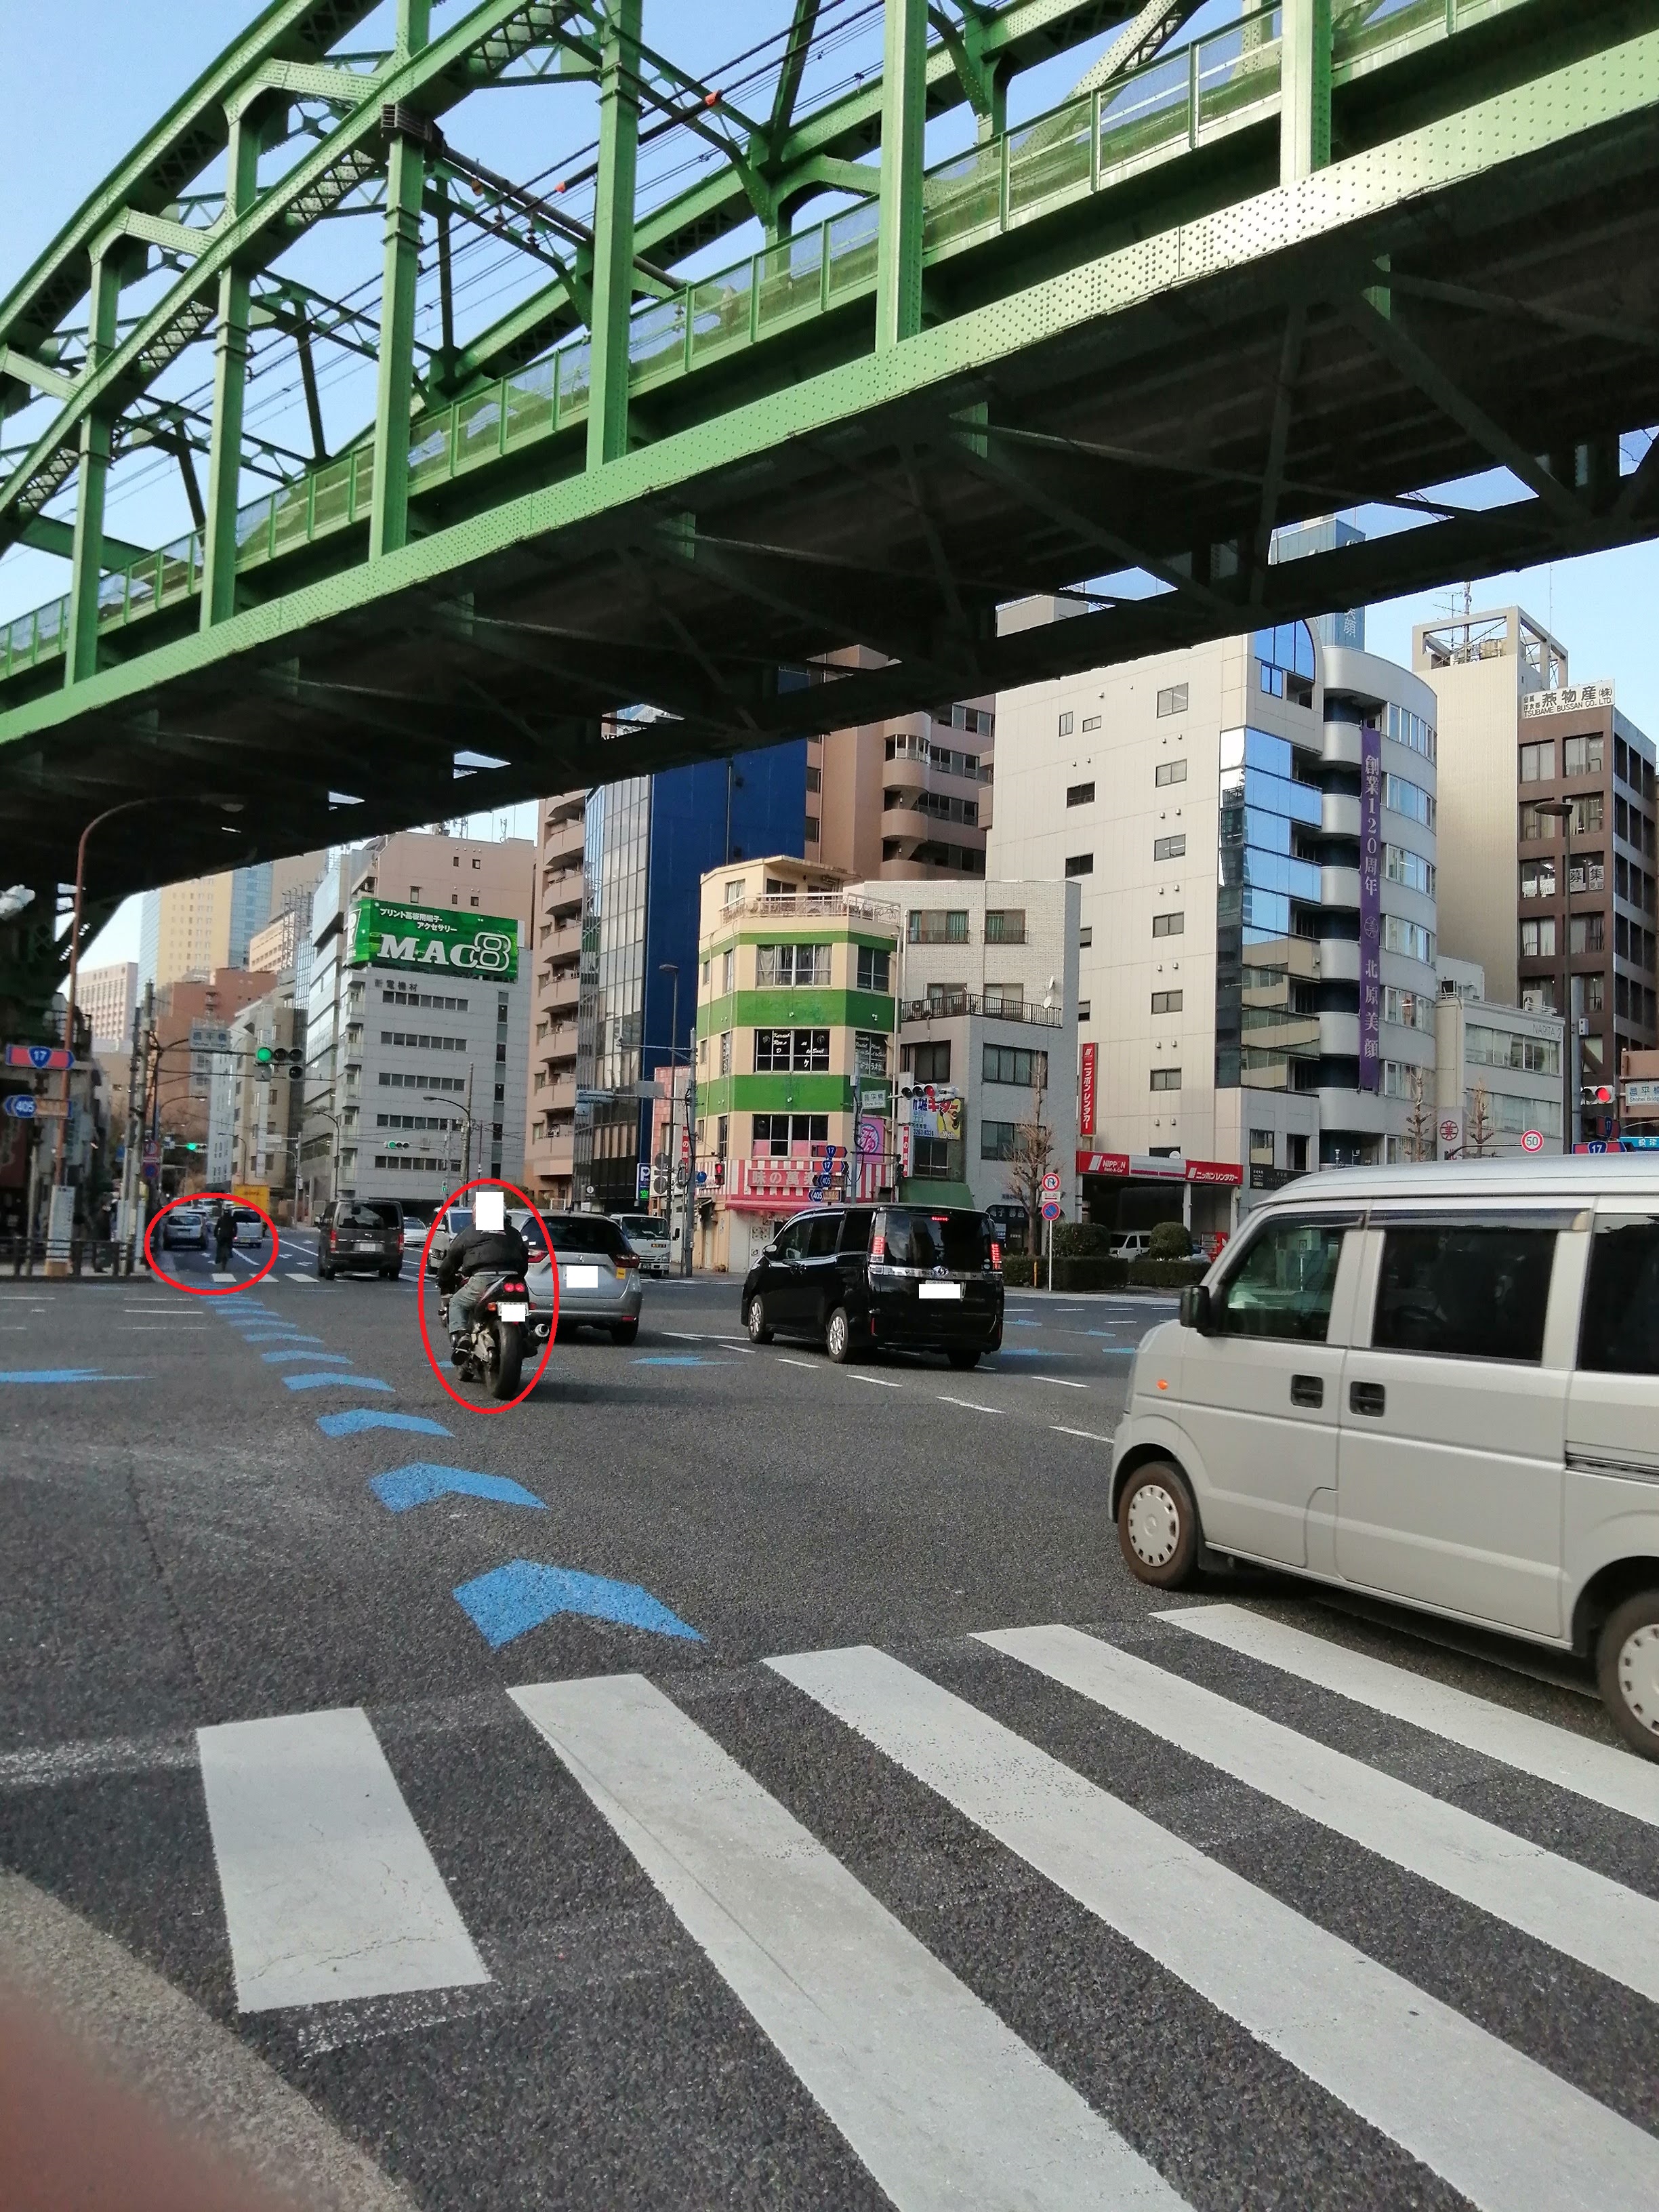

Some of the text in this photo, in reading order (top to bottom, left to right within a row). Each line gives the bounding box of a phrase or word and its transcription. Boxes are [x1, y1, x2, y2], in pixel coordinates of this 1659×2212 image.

[1524, 706, 1554, 717] TSUBAME
[1557, 702, 1583, 712] BUSSAN
[417, 922, 457, 933] アクセサリー
[1364, 959, 1378, 1059] 北原美顔
[34, 1050, 47, 1061] 17
[1083, 1063, 1092, 1130] ニッポンレンタカー
[1526, 1136, 1538, 1146] 50
[1591, 1145, 1603, 1153] 17
[1103, 1160, 1126, 1169] NIPPON
[1196, 1171, 1238, 1181] ニッポンレンタカー
